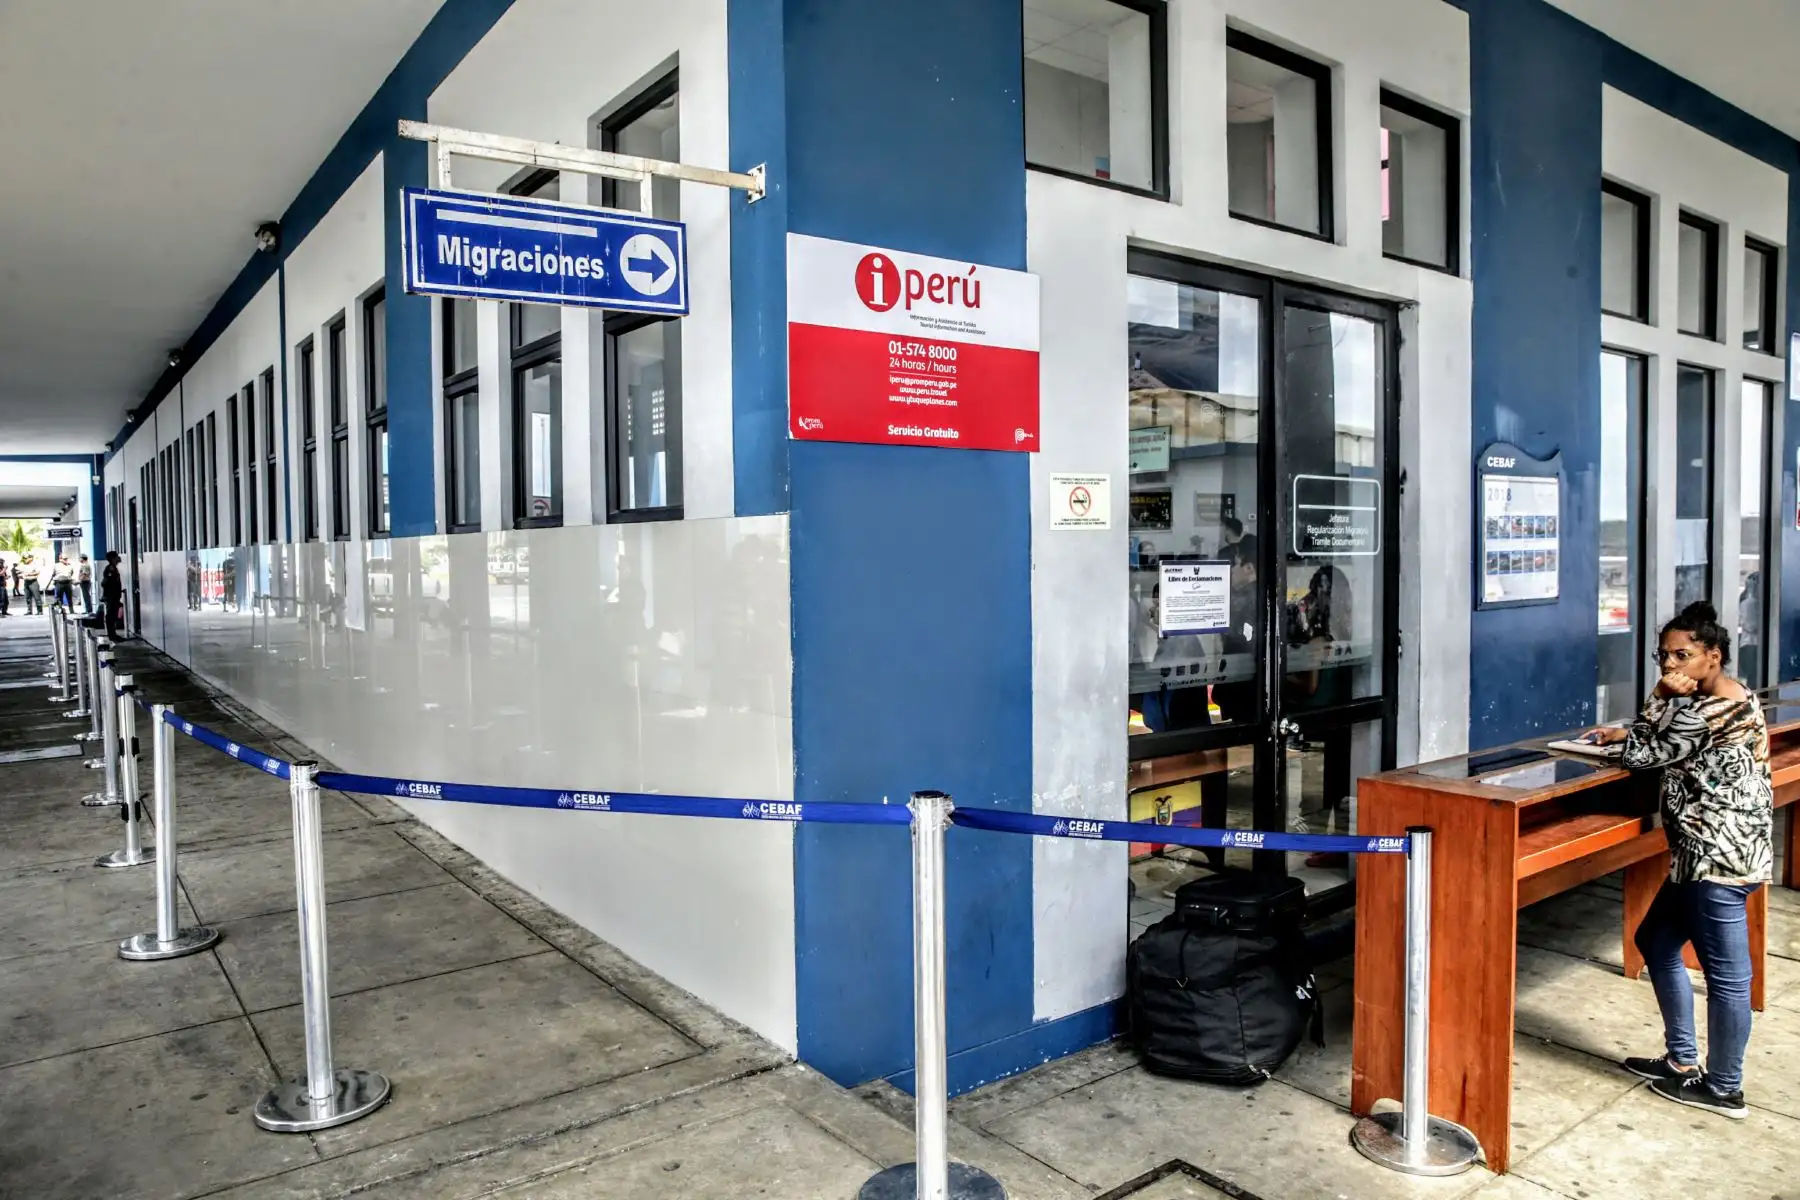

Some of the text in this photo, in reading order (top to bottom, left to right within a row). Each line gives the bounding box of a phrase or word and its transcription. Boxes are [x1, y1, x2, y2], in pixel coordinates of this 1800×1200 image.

[437, 234, 604, 279] Migraciones
[888, 340, 957, 361] 01-574 8000
[889, 357, 957, 374] 24 horas / hours
[887, 424, 959, 439] Servicio Gratuito
[1487, 456, 1516, 468] CEBAF
[408, 782, 442, 795] CEBAF
[573, 793, 611, 805] CEBAF
[760, 802, 803, 815] CEBAF
[1068, 820, 1105, 833] CEBAF
[1234, 832, 1265, 844] CEBAF
[1378, 838, 1404, 848] CEBAF
